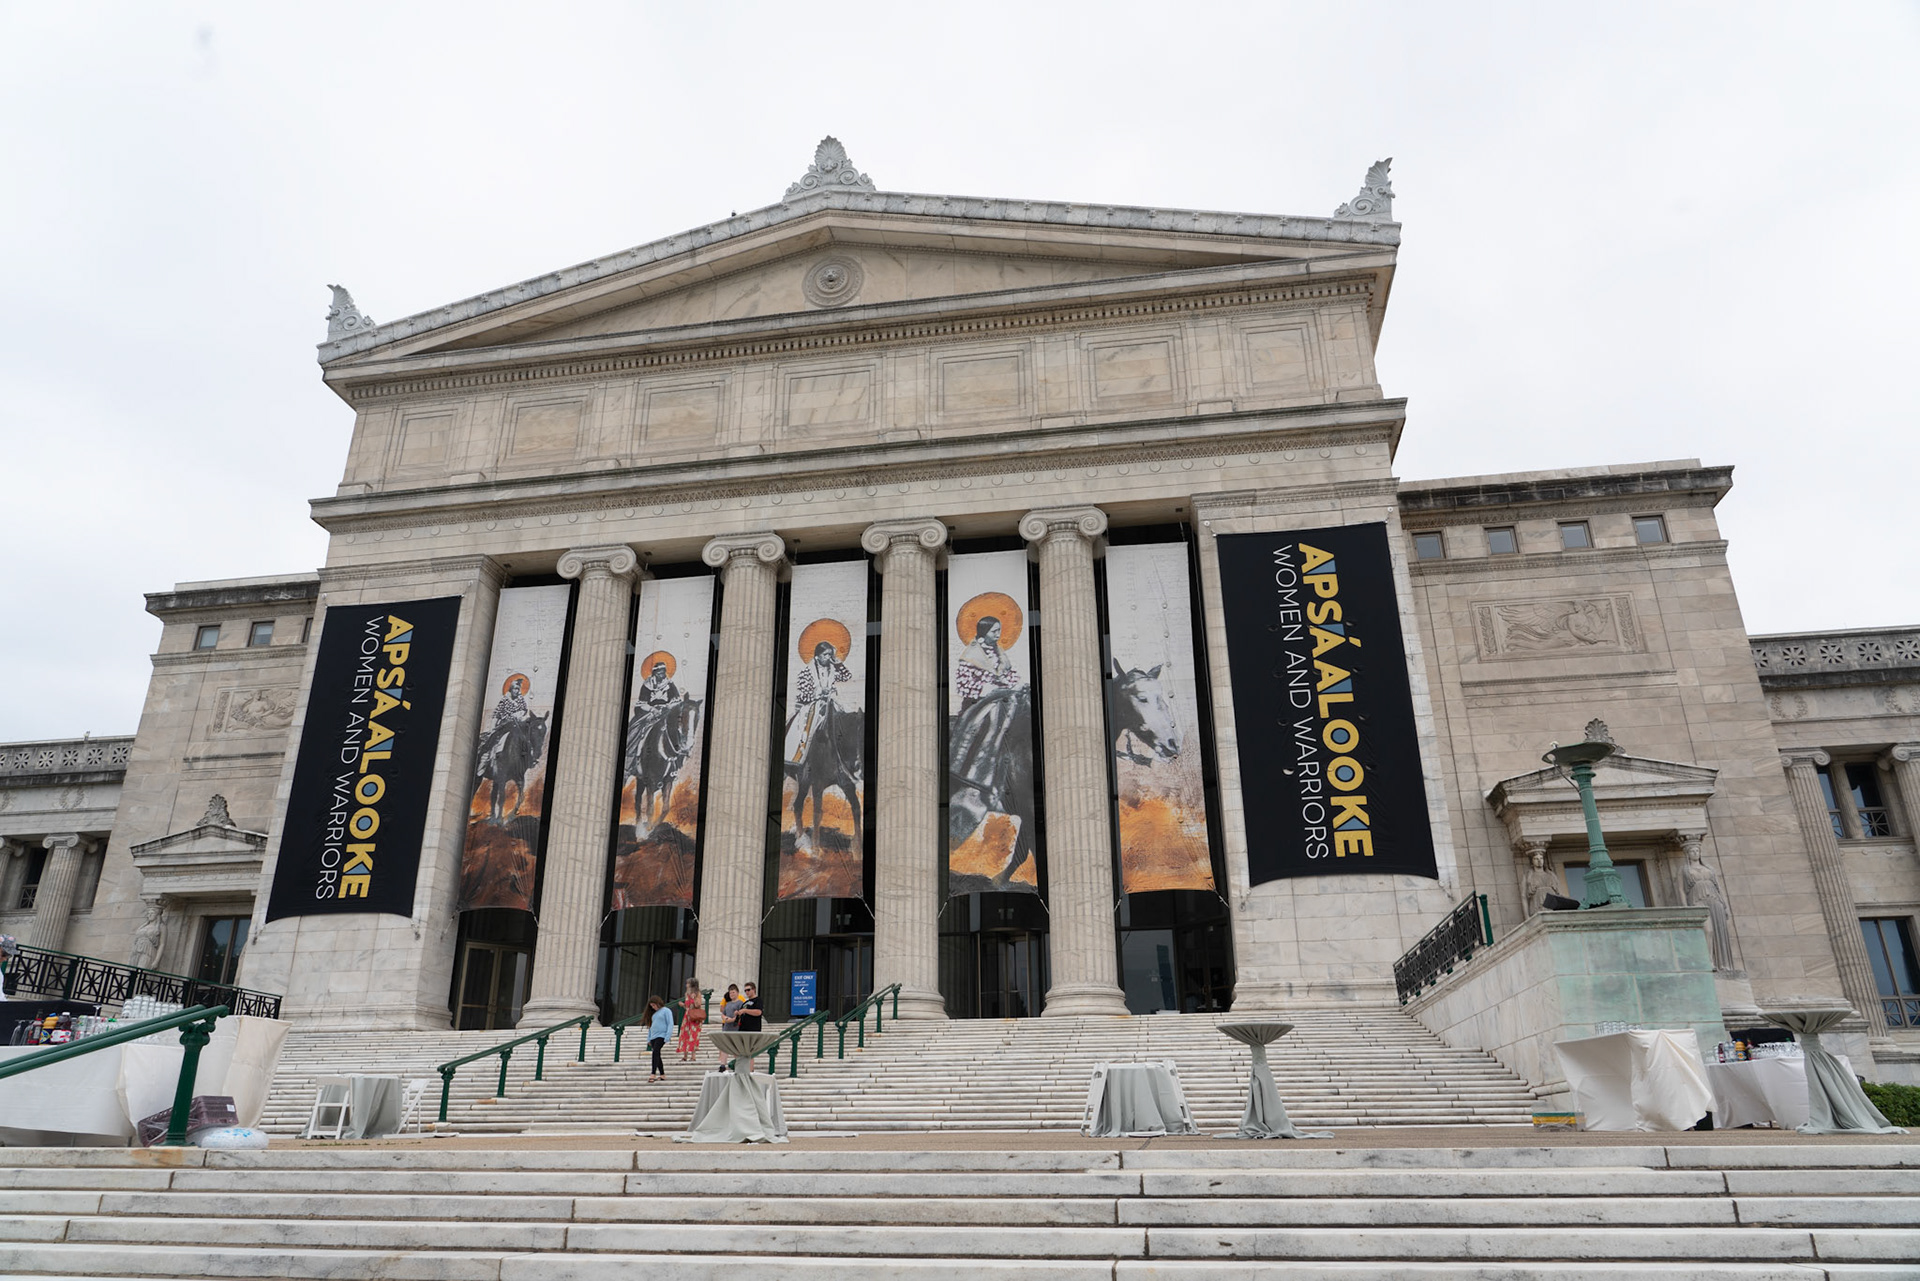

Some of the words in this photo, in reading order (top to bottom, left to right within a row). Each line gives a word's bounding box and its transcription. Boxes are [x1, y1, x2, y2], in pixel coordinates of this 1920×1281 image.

[1273, 545, 1303, 640] WOMEN
[352, 616, 384, 703] WOMEN
[1285, 651, 1312, 708] AND
[1299, 543, 1373, 857] APSÁALOOKE
[338, 615, 414, 898] APSÁALOOKE
[340, 712, 365, 763] AND
[1293, 717, 1329, 858] WARRIORS
[316, 772, 354, 899] WARRIORS
